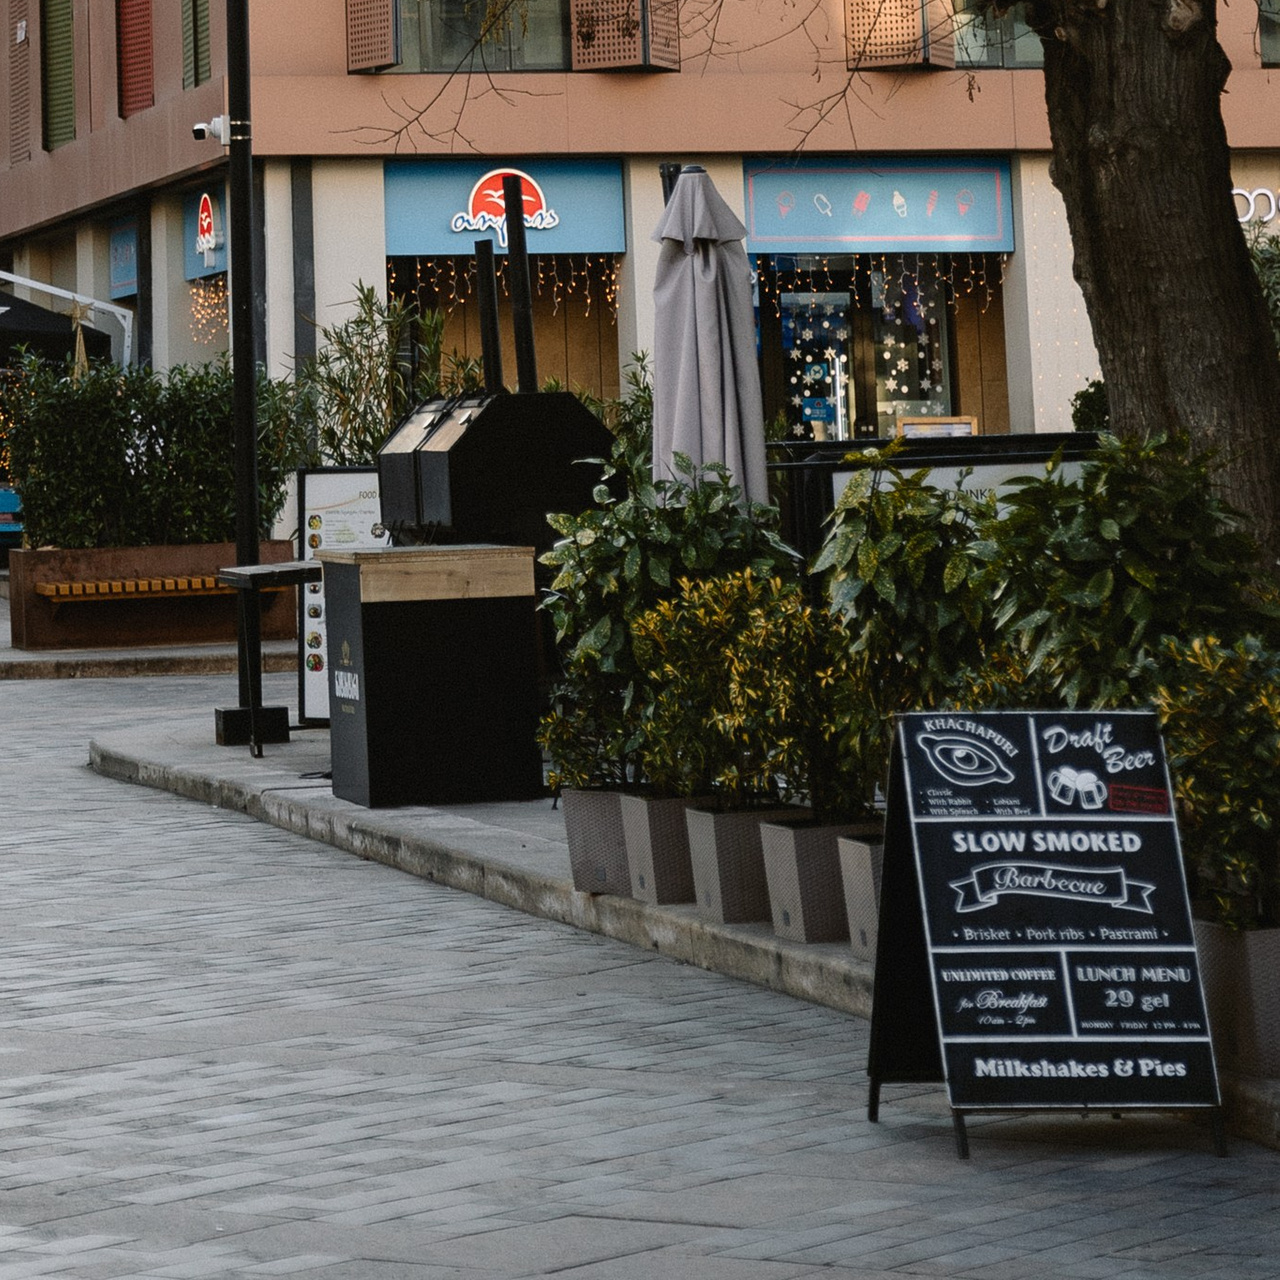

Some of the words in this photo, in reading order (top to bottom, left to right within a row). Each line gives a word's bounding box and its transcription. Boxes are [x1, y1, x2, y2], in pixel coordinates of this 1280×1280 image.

[359, 490, 378, 500] FOOD
[923, 718, 1019, 758] KHACHAPURI
[1043, 722, 1114, 754] Draft
[1103, 746, 1156, 774] Beer
[928, 797, 947, 806] With
[948, 797, 972, 806] Rabbit
[930, 807, 949, 816] With
[950, 807, 979, 817] Spinach
[994, 807, 1013, 816] With
[1014, 807, 1031, 816] Beef
[953, 831, 1026, 853] SLOW
[1032, 831, 1142, 853] SMOKED
[993, 866, 1108, 896] Barbecue
[964, 926, 1011, 941] Brisket
[1026, 926, 1057, 941] Pork
[1059, 926, 1086, 941] ribs
[1099, 925, 1159, 940] Pastrami
[942, 968, 1009, 982] UNLIMITED
[1009, 967, 1057, 981] COFFEE
[1077, 966, 1136, 982] LUNCH
[1141, 966, 1191, 982] MENU
[956, 998, 974, 1013] for
[976, 989, 1048, 1014] Breakfast
[1105, 989, 1134, 1008] 29
[1141, 993, 1170, 1012] gel
[979, 1016, 1005, 1025] 10am
[1015, 1015, 1036, 1028] 2pm
[1081, 1021, 1114, 1029] MONDAY
[1120, 1021, 1149, 1029] FRIDAY
[974, 1057, 1109, 1078] Milkshakes
[1113, 1057, 1134, 1078] &
[1138, 1057, 1187, 1077] Pies
